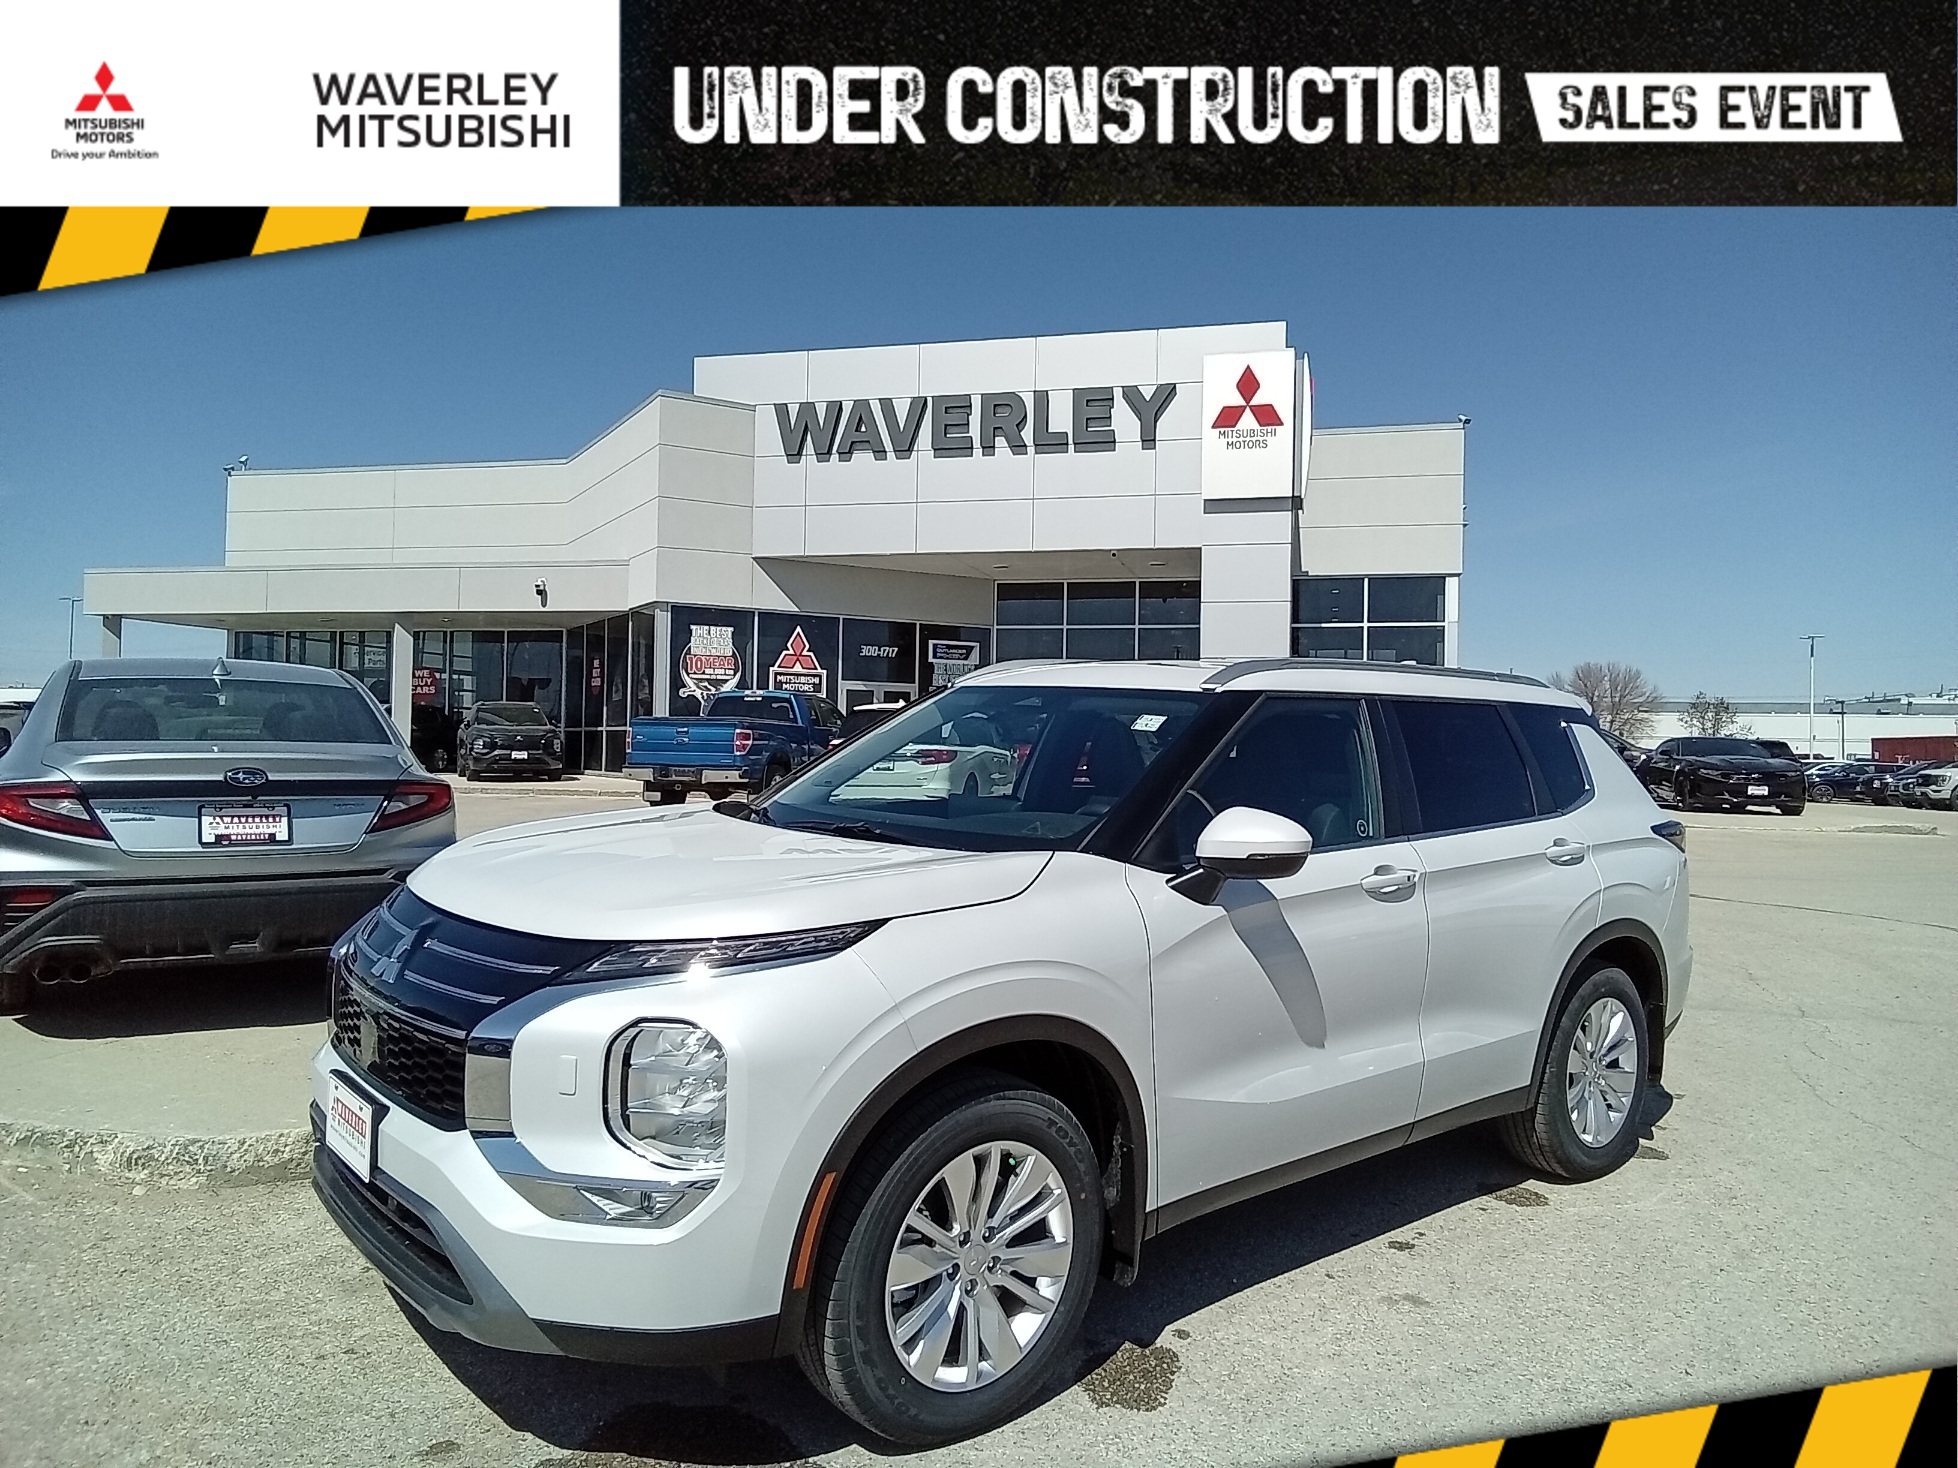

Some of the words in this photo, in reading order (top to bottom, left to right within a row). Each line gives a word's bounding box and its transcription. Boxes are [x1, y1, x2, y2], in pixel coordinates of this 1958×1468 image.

[774, 383, 1177, 464] WAVERLEY
[1218, 428, 1277, 439] MITSUBISHI
[1226, 439, 1268, 450] MOTORS
[690, 625, 710, 637] THE
[710, 626, 734, 638] BEST
[859, 645, 899, 658] 300-1717
[687, 655, 705, 674] 10
[704, 656, 734, 668] YEAR
[414, 669, 430, 678] WE
[412, 678, 433, 687] BUY
[776, 674, 820, 685] MITSUBISHI
[411, 686, 436, 695] CARS
[782, 683, 814, 692] MOTORS
[222, 815, 282, 824] WAVERLEY
[230, 833, 270, 841] WAVERLEY
[337, 1116, 366, 1150] MITSUBISHI
[1045, 1116, 1086, 1164] TOYO
